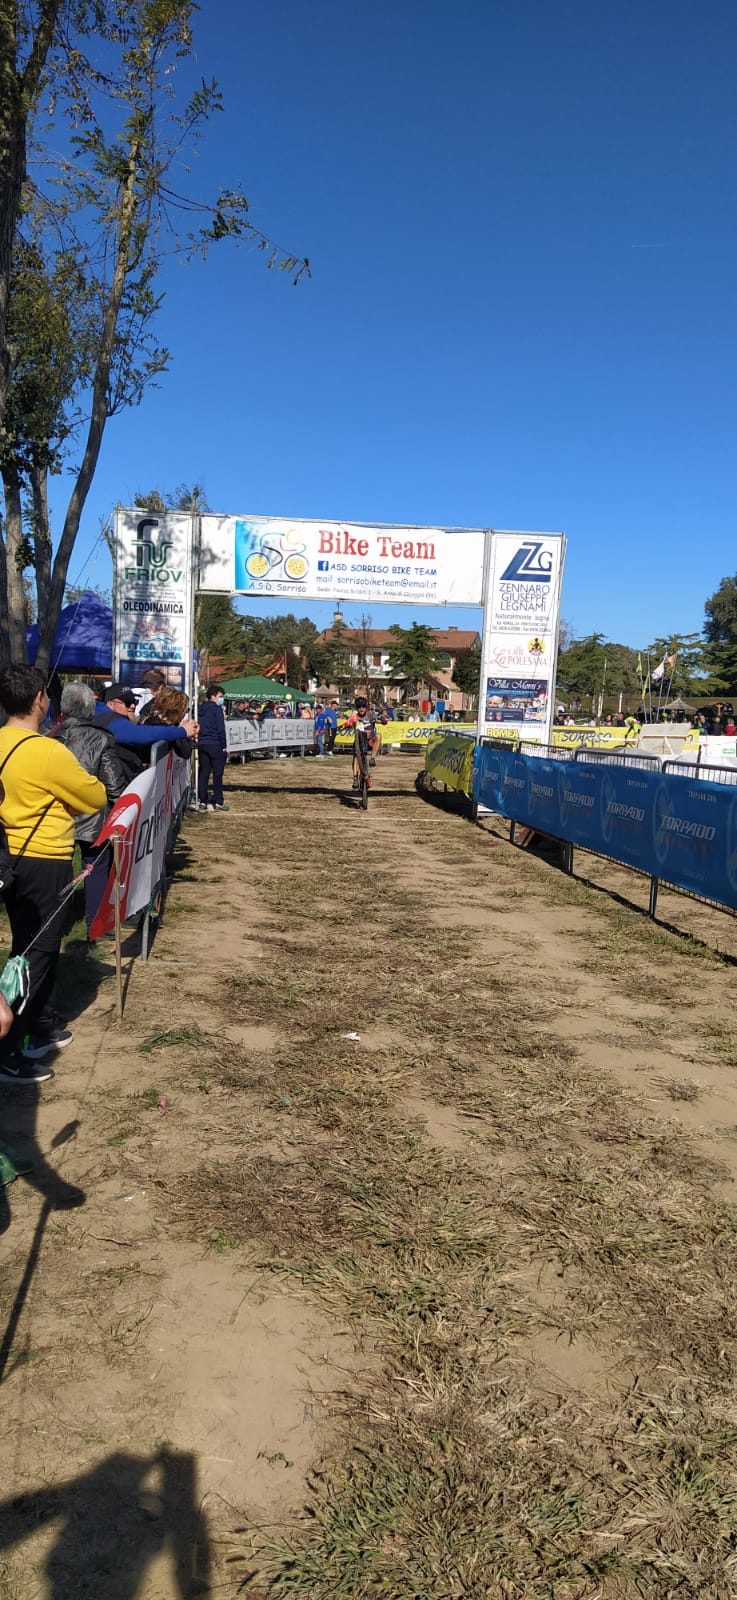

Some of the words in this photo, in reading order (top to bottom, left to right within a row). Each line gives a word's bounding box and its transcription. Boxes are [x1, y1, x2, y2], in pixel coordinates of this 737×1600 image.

[317, 530, 369, 556] Bike
[377, 537, 437, 560] Team
[125, 567, 182, 583] FRIOV
[331, 563, 348, 571] ASD
[351, 564, 389, 574] SORRISO
[392, 566, 411, 575] BIKE
[414, 567, 437, 576] TEAM
[276, 584, 307, 593] Sorriso
[499, 583, 550, 596] ZENNARO
[501, 592, 547, 603] GIUSEPPE
[123, 601, 184, 614] OLEODINAMICA
[500, 601, 546, 612] LEGNAMI
[127, 649, 182, 660] ROSOLINA
[507, 655, 547, 667] POLESANA
[607, 800, 645, 821] TORPADO
[661, 814, 716, 841] TORPADO
